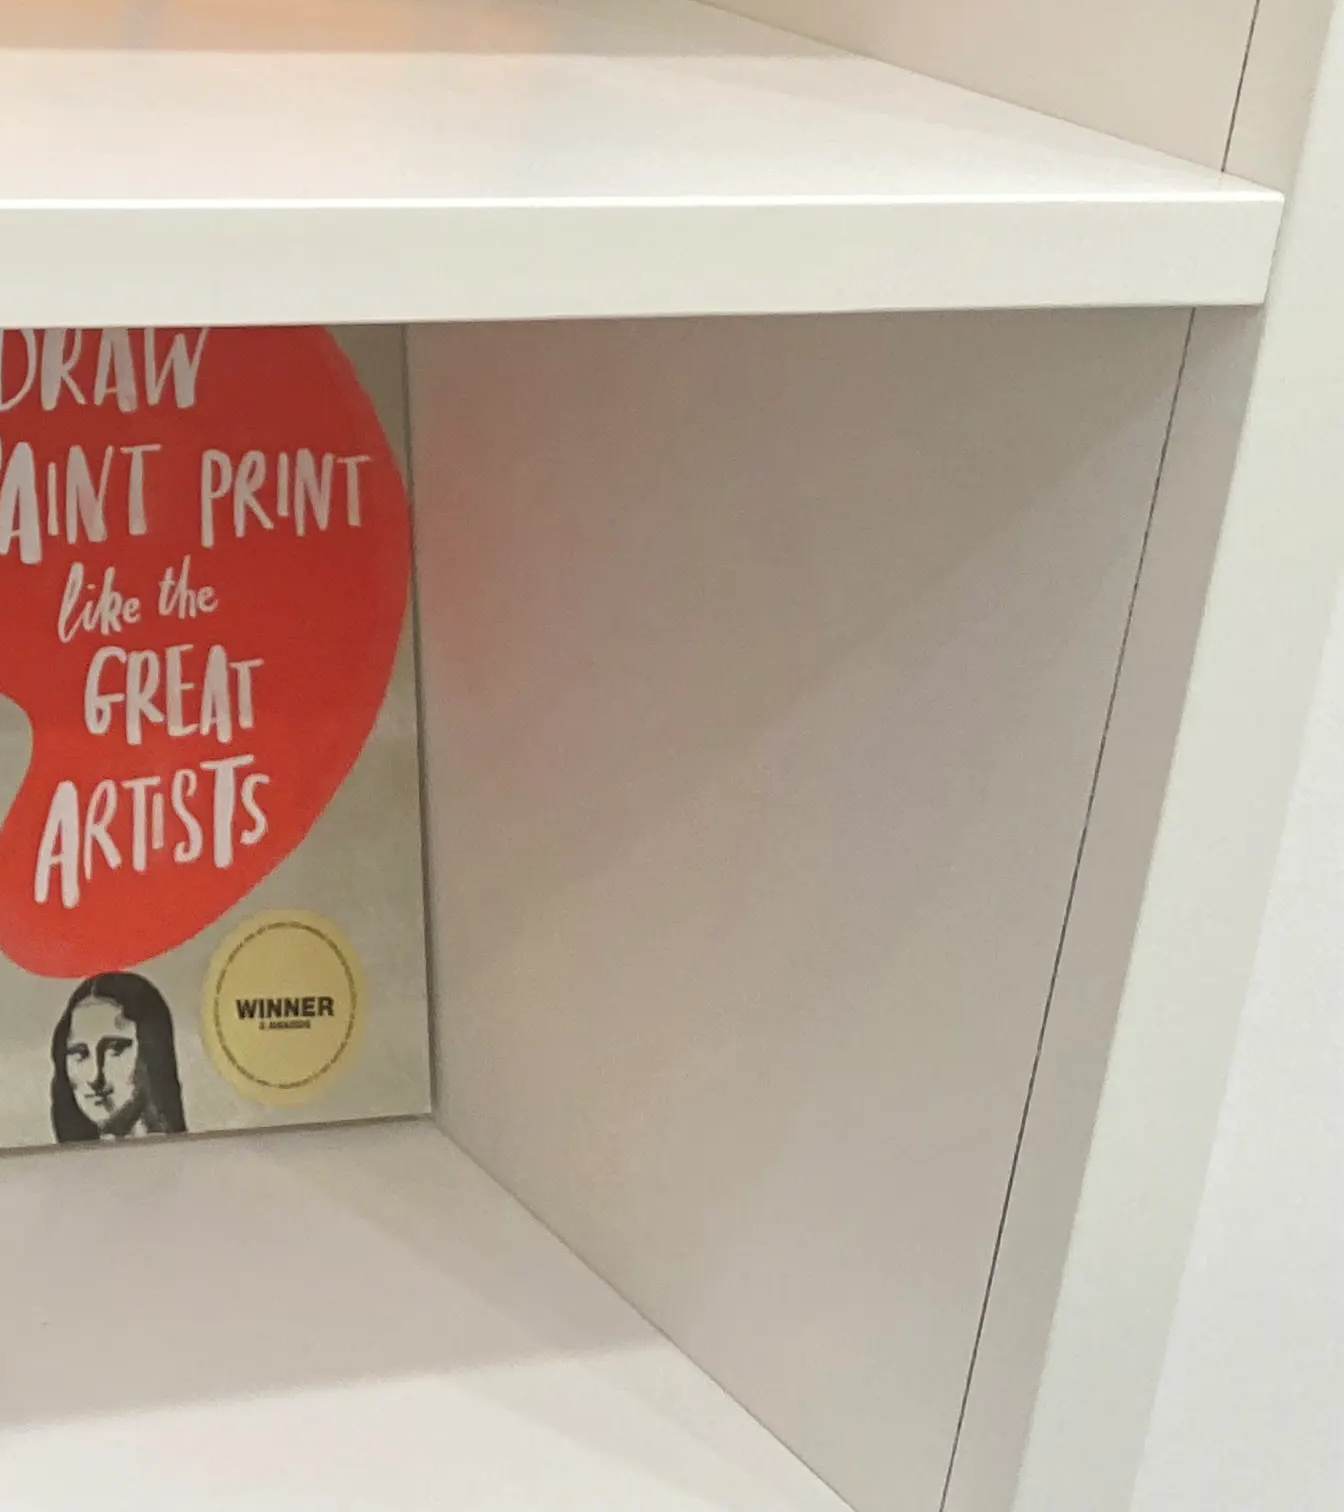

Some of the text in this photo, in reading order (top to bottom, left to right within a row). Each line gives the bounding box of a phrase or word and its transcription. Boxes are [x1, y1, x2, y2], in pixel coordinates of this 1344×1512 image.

[200, 447, 370, 548] PRINT
[58, 555, 218, 644] like the
[83, 643, 264, 747] GREAT
[33, 753, 271, 908] ARTISTS
[236, 996, 335, 1021] WINNER
